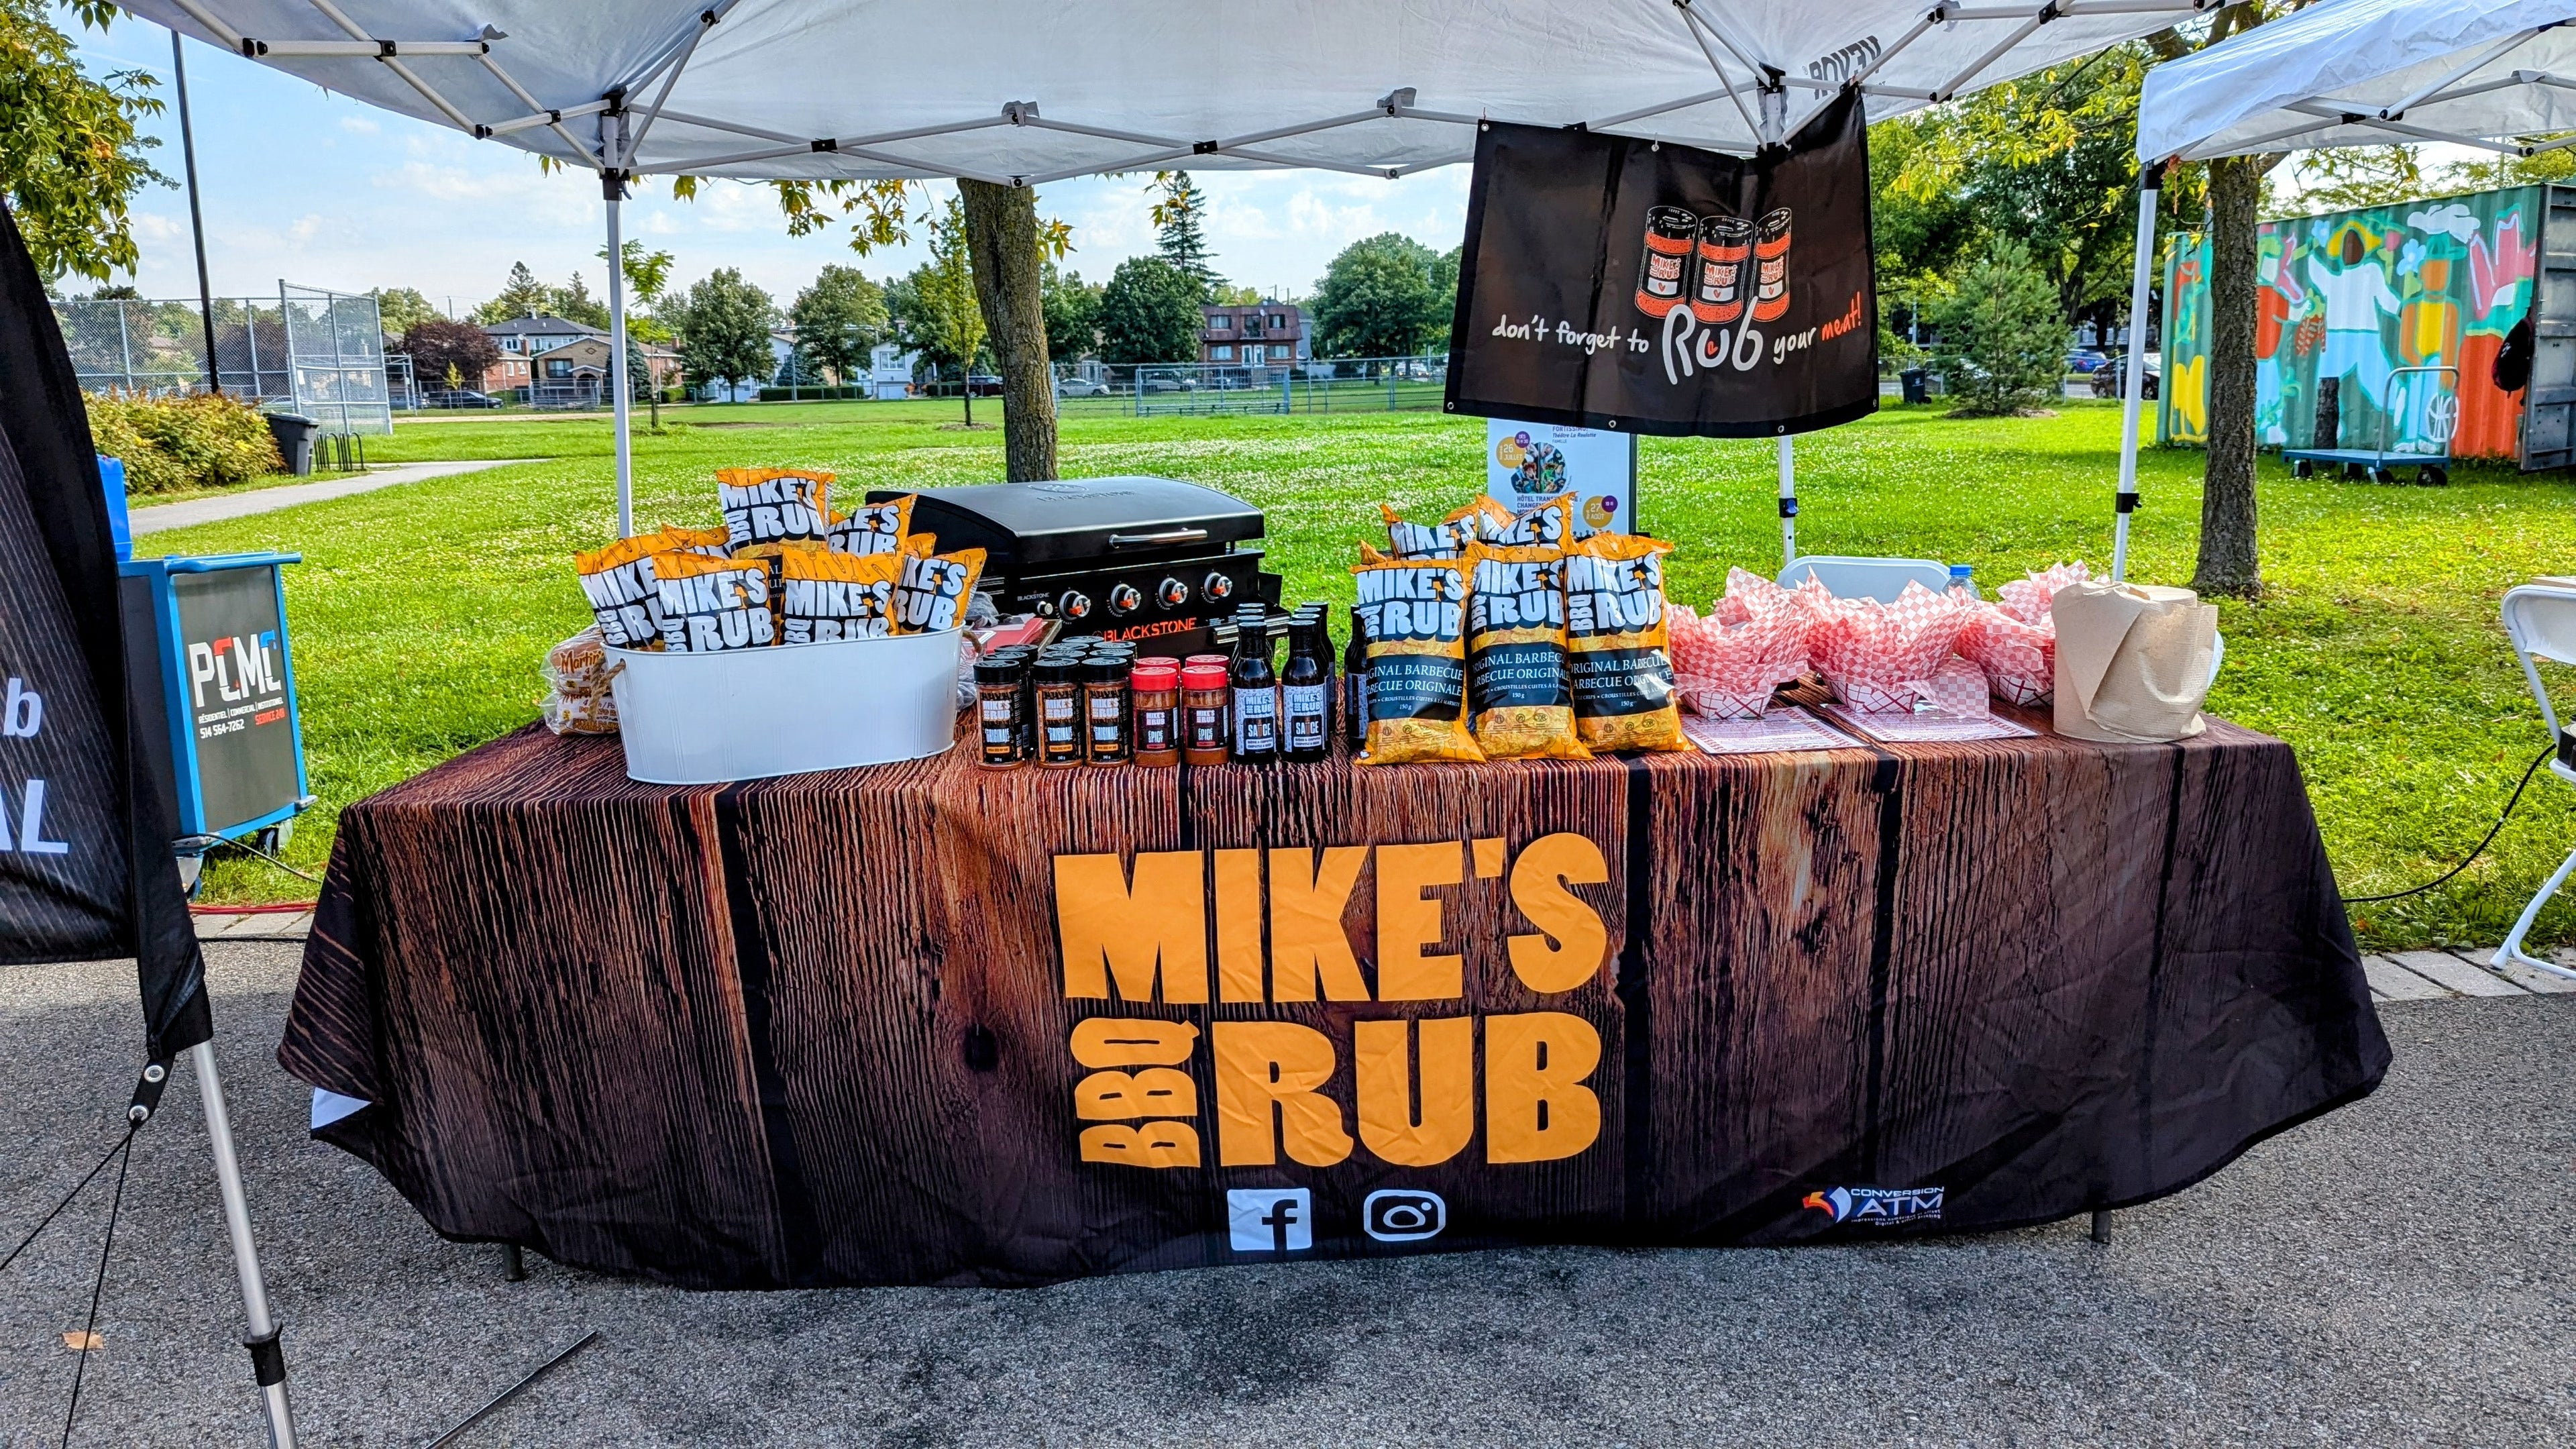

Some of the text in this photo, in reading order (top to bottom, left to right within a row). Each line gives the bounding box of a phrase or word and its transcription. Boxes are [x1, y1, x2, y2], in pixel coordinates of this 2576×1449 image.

[1658, 267, 1680, 279] RUB
[1713, 275, 1735, 286] RUB
[1768, 269, 1783, 283] RUB
[1492, 291, 1862, 384] don't forget to Rub your meat!
[1503, 444, 1513, 453] 26
[718, 478, 816, 511] MIKE'S
[1591, 503, 1601, 513] 27
[725, 508, 752, 544] BBQ
[1475, 558, 1565, 594] MIKE'S
[1566, 551, 1660, 592] MIKE'S
[656, 568, 768, 616] MIKE'S
[784, 580, 891, 616] MIKE'S
[1017, 592, 1050, 601] BLACKSTONE
[1356, 568, 1464, 605] MIKE'S
[894, 590, 957, 629] RUB
[1383, 601, 1462, 635] RUB
[1471, 594, 1487, 631] BBQ
[1490, 590, 1564, 625] RUB
[1568, 594, 1594, 631] BBQ
[1595, 590, 1662, 629] RUB
[596, 608, 629, 644] BBQ
[688, 607, 775, 652] RUB
[1104, 617, 1197, 642] BLACKSTONE
[559, 650, 604, 675] Martin'
[1405, 664, 1463, 680] BARBECUE
[1623, 655, 1666, 670] BARBECUE
[1246, 695, 1272, 704] MIKE'S
[1293, 692, 1320, 702] MIKE'S
[1405, 680, 1462, 696] ORIGINALE
[983, 700, 1010, 710] MIKE'S
[990, 710, 1010, 720] RUB
[1046, 698, 1073, 708] MIKE'S
[1054, 708, 1073, 718] RUB
[1091, 698, 1119, 708] MIKE'S
[1099, 707, 1119, 717] RUB
[1254, 704, 1272, 713] RUB
[1301, 702, 1320, 711] RUB
[200, 718, 245, 739] 514 564-7262
[1053, 832, 1609, 1004] MIKE'S
[1070, 1017, 1201, 1169] BBQ
[1212, 1012, 1602, 1167] RUB
[1851, 1186, 1944, 1197] CONVERSION
[1857, 1193, 1943, 1217] ATM
